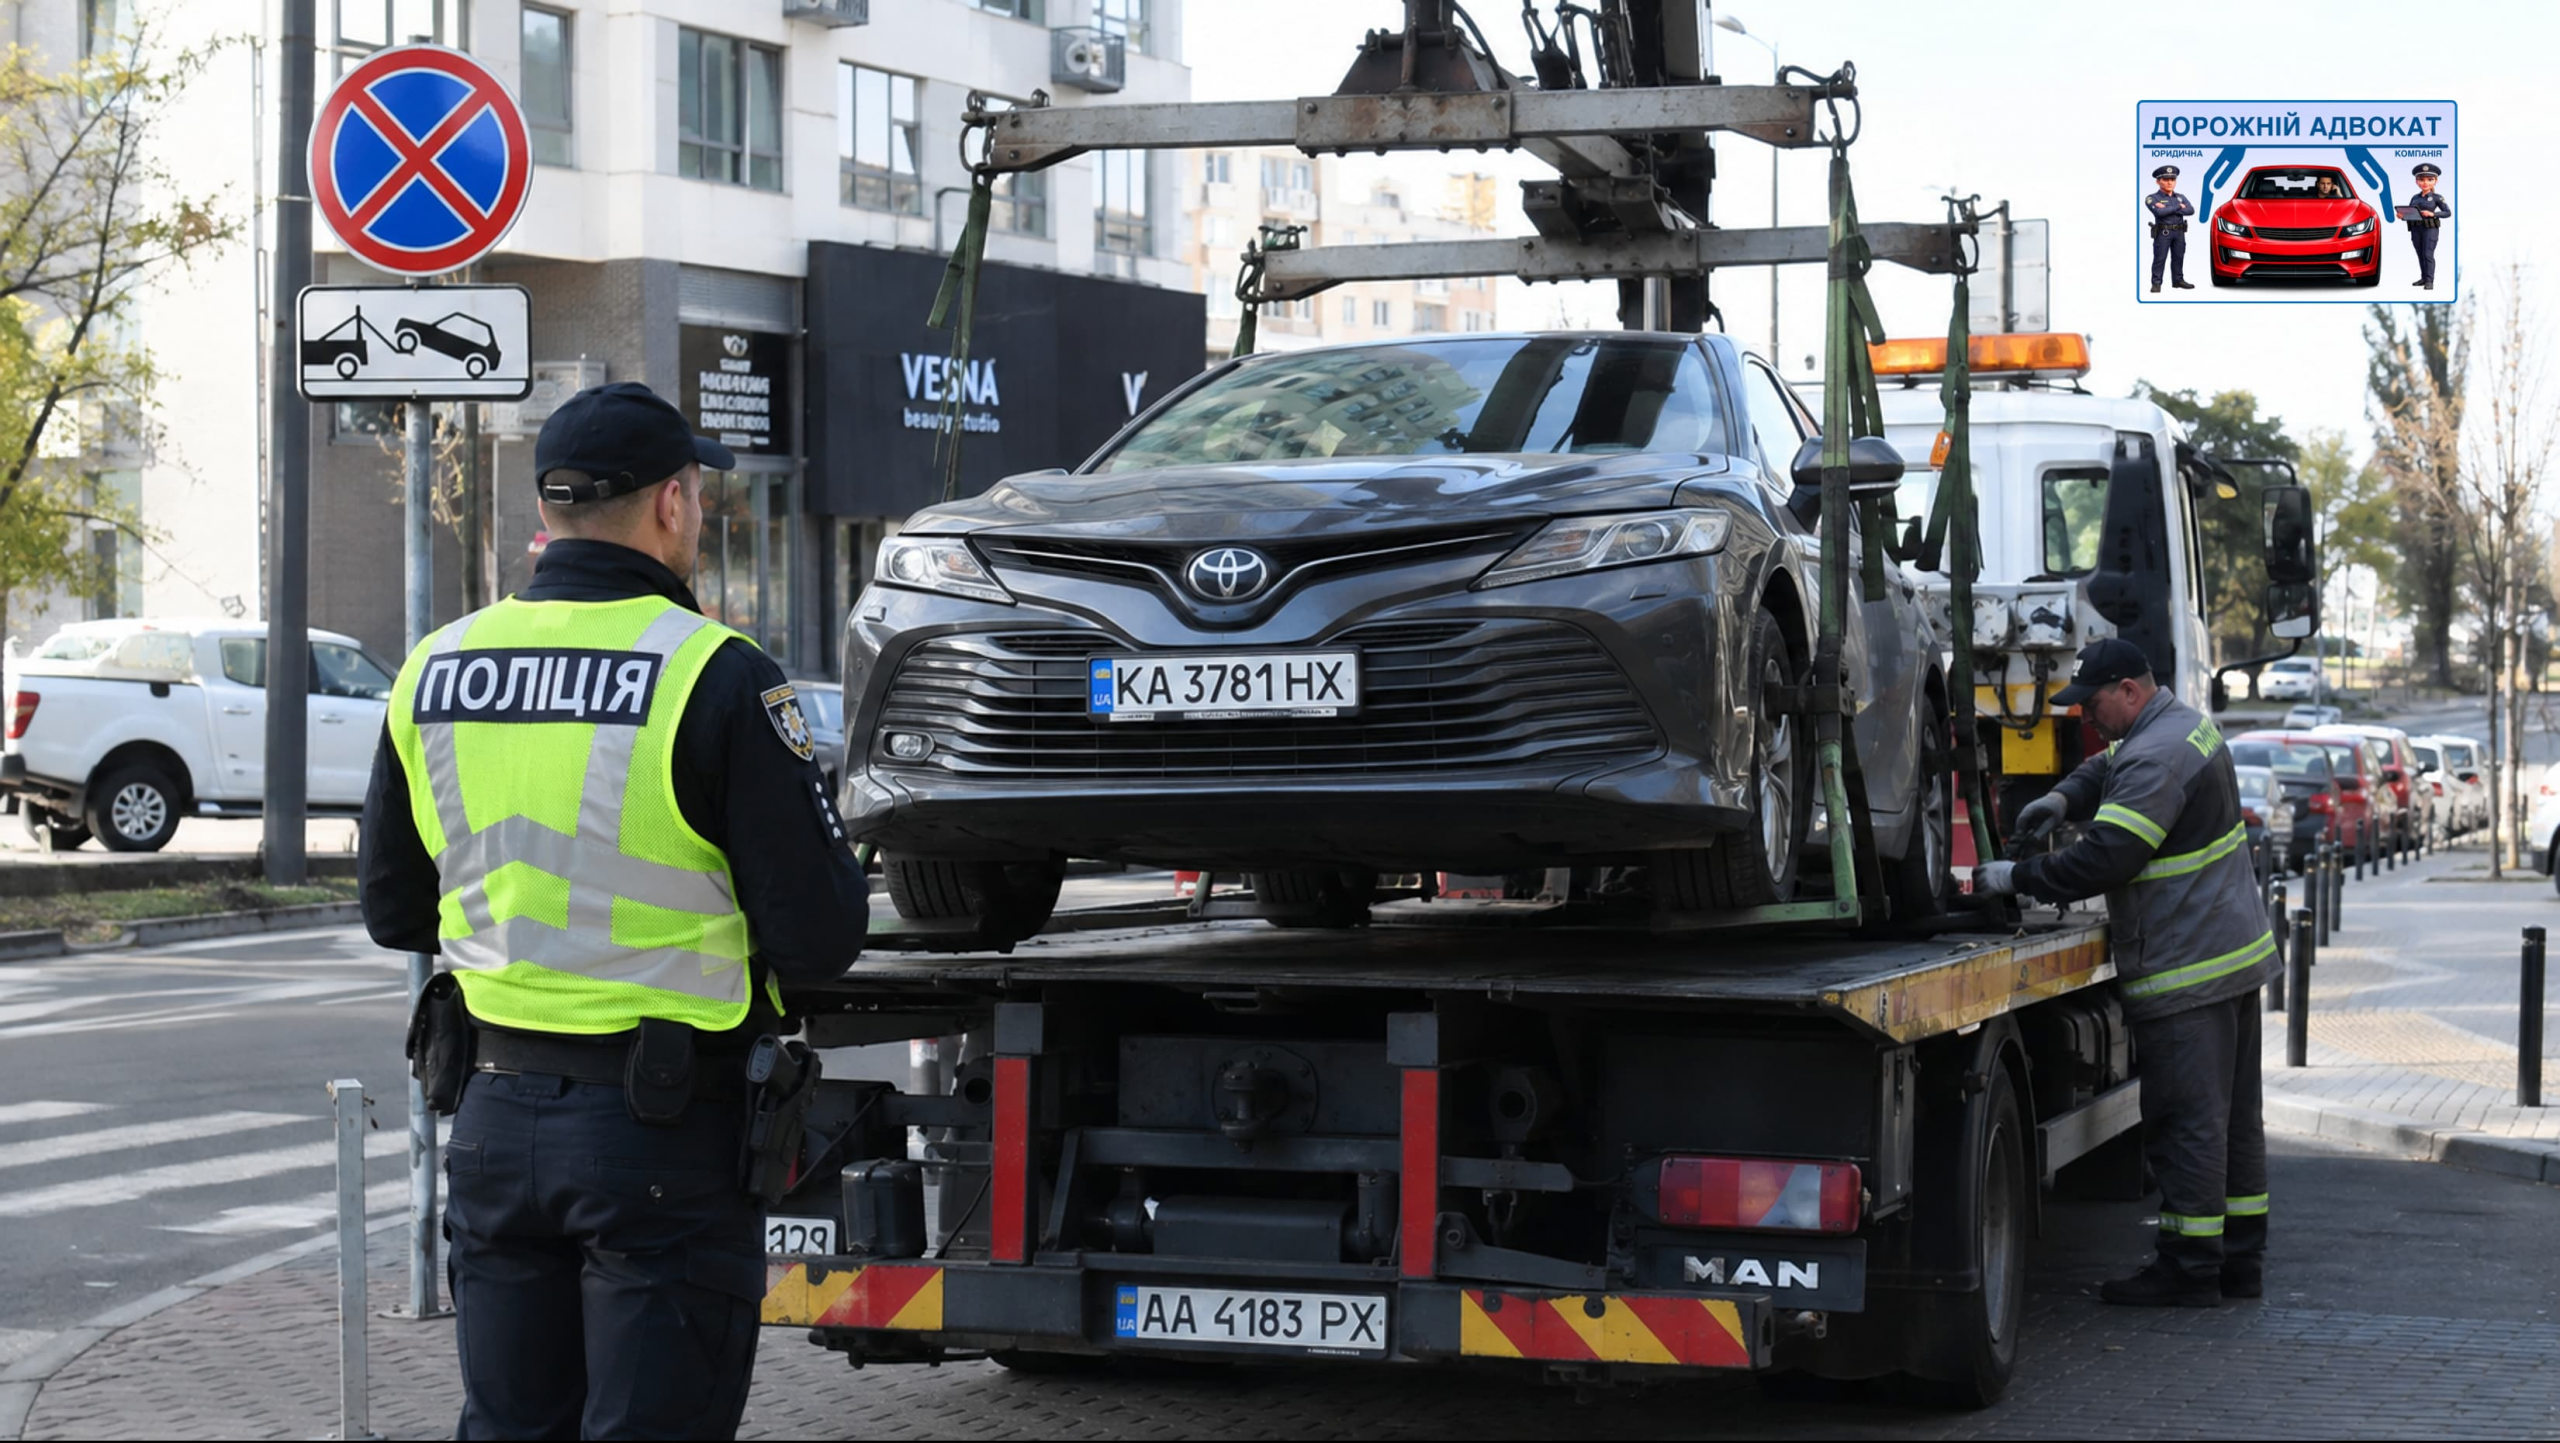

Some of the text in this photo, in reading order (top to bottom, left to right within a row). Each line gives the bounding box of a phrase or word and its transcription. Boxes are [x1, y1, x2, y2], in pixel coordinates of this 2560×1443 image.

[421, 657, 653, 717] ПОЛІЦІЯ
[1184, 663, 1273, 704] 3781
[1684, 1256, 1819, 1289] MAN
[1142, 1294, 1197, 1334] AA
[1214, 1297, 1303, 1338] 4183
[1320, 1301, 1377, 1342] PX
